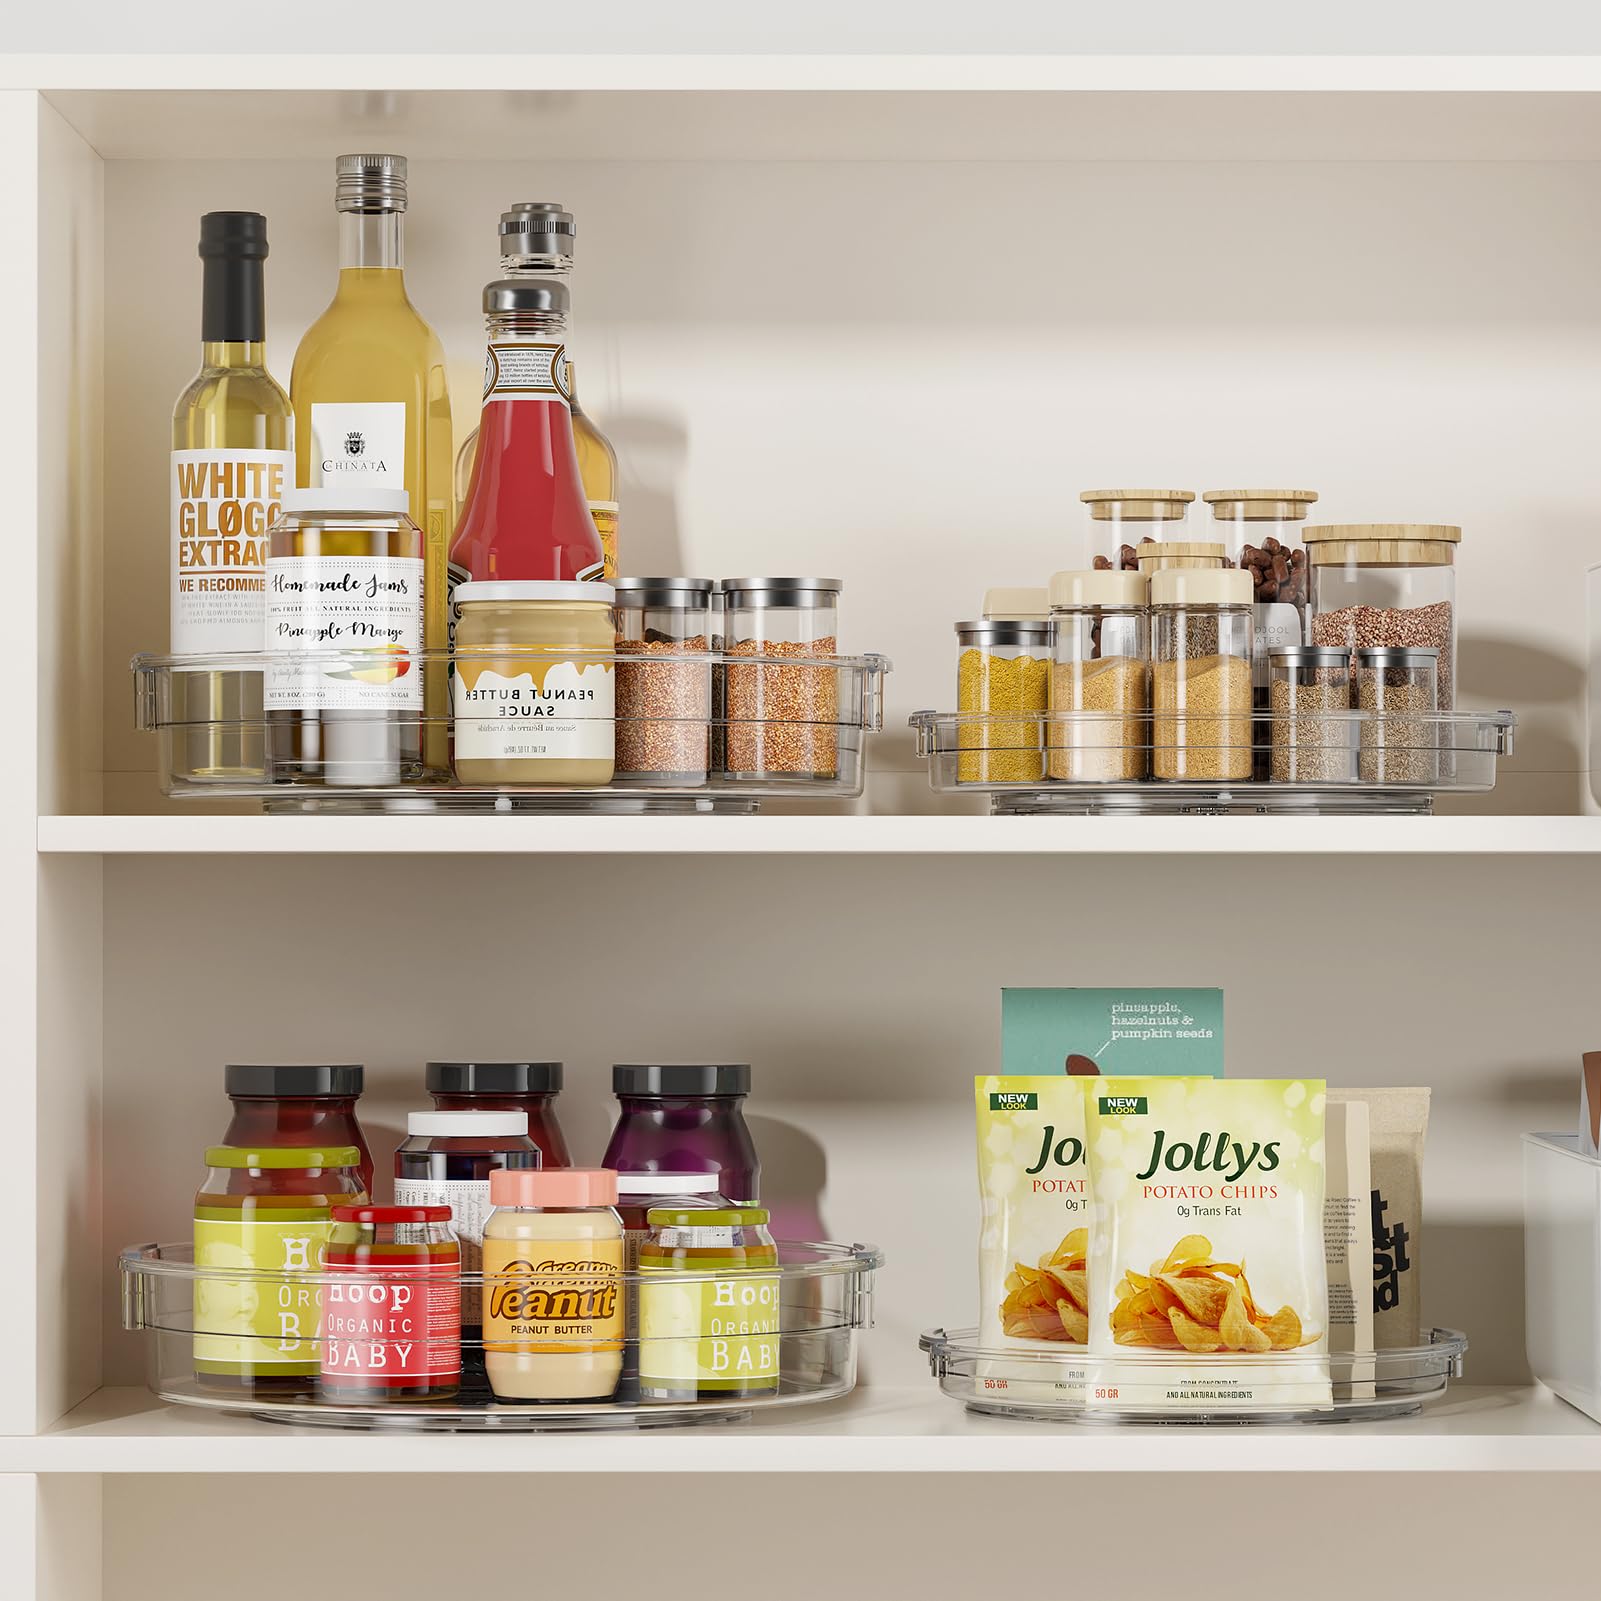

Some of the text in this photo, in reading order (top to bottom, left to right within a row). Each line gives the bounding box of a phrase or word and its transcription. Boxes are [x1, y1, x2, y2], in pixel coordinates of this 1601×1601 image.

[322, 459, 387, 472] CHINATA
[178, 462, 283, 499] WHITE
[179, 578, 194, 593] WE
[271, 573, 408, 598] Homemade Jams
[276, 621, 404, 642] Pineapple Mango
[1111, 1015, 1194, 1026] hazelnuts &
[1111, 1028, 1213, 1041] pumpkin seeds
[998, 1094, 1029, 1103] NEW
[1107, 1098, 1138, 1107] NEW
[1025, 1125, 1086, 1174] Jo
[1136, 1130, 1281, 1182] Jollys
[1143, 1185, 1278, 1199] POTATO CHIPS
[1177, 1205, 1242, 1217] 0g Trans Fat
[328, 1280, 412, 1311] Hoop
[490, 1259, 617, 1320] Peanut
[328, 1313, 412, 1333] ORGANIC
[511, 1325, 593, 1335] PEANUT BUTTER
[328, 1335, 413, 1368] BABY
[1068, 1371, 1085, 1379] FROM
[1095, 1388, 1119, 1398] 50 GR
[1166, 1391, 1253, 1399] AND ALL NATURAL INGREDIENTS
